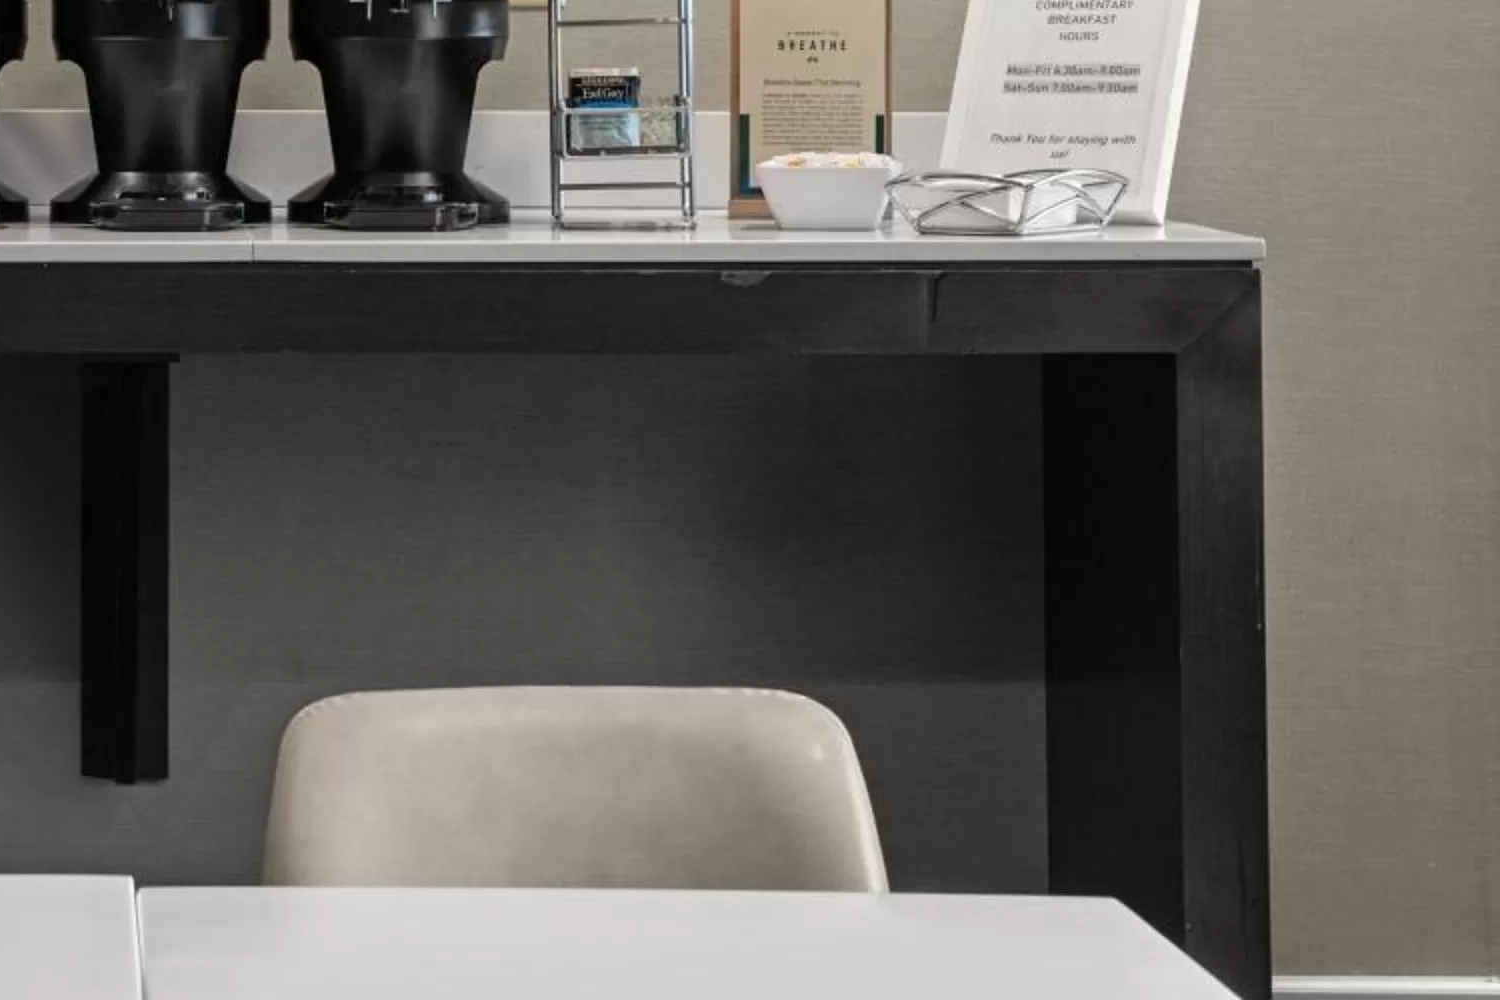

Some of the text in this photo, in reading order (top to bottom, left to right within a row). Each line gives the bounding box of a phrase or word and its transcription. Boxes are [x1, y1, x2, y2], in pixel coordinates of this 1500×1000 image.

[1035, 0, 1134, 12] COMPLIMENTARY
[1047, 14, 1117, 25] BREAKFAST
[1059, 31, 1100, 41] HOURS
[776, 39, 847, 52] BREATHE
[990, 132, 1023, 144] Thank
